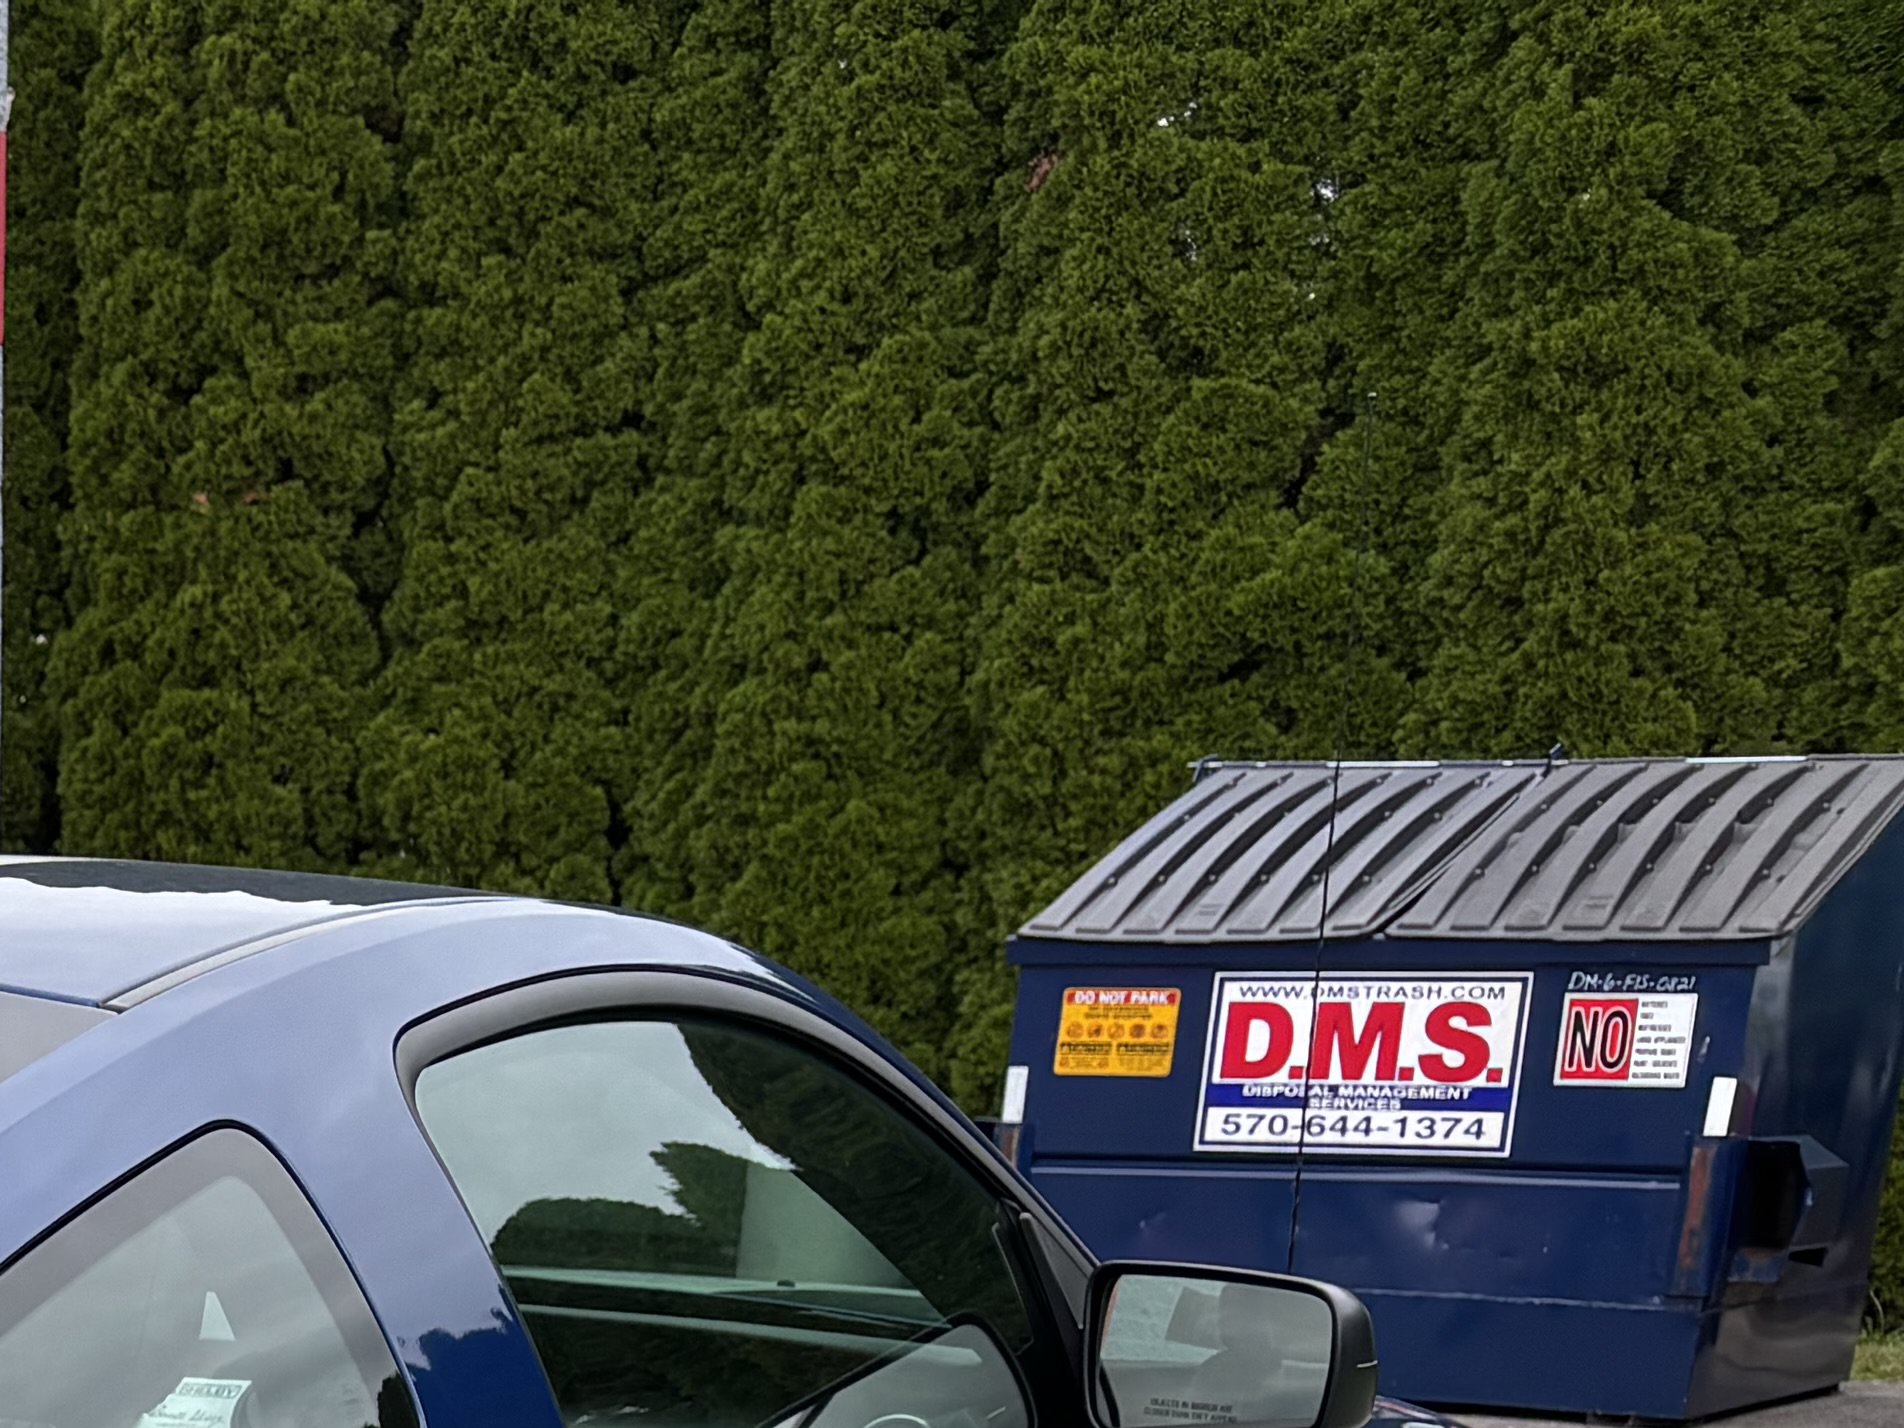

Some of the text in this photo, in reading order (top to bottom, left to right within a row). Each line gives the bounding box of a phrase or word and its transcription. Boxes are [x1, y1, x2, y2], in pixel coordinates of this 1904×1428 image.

[1219, 1001, 1503, 1083] D.M.S.
[1564, 1006, 1631, 1073] NO
[1307, 1096, 1401, 1111] SERVICES
[1338, 1086, 1473, 1101] MANAGEMENT
[1220, 1112, 1486, 1141] 570-644-1374
